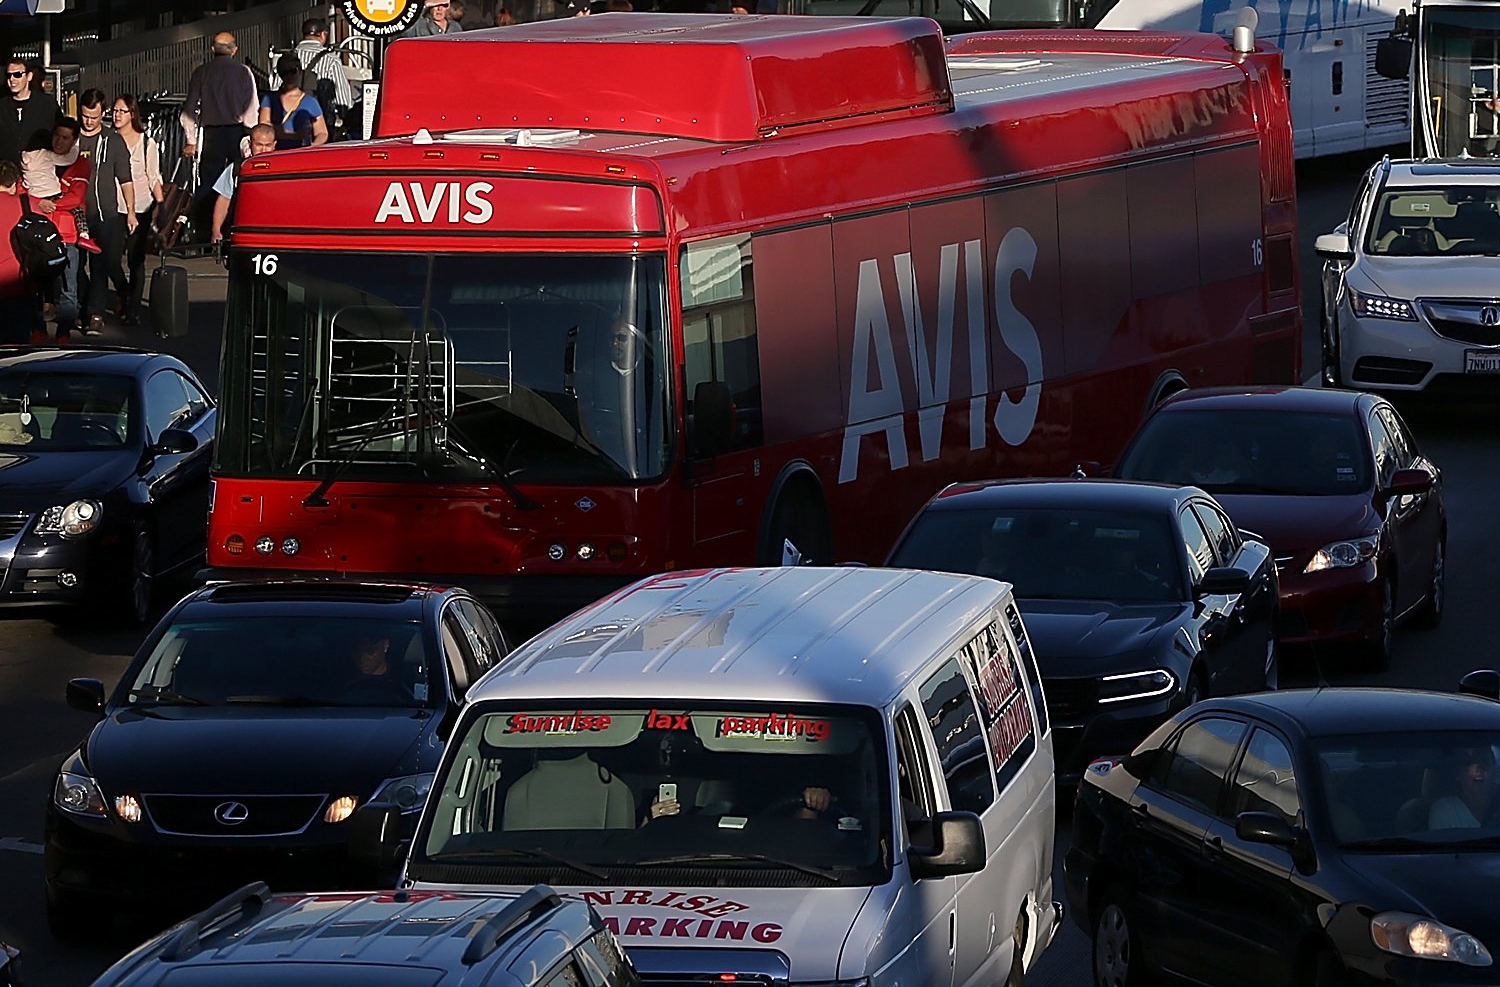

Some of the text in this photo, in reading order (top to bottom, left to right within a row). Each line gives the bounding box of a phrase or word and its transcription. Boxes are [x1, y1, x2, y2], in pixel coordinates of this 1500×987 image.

[343, 0, 418, 35] Private Parking Lots
[375, 182, 494, 224] AVIS
[251, 253, 279, 276] 16
[1251, 238, 1263, 266] 16
[838, 227, 1044, 484] AVIS
[510, 708, 832, 741] Sunrise lax parking
[578, 889, 750, 919] NRISE
[600, 916, 783, 944] ARKING
